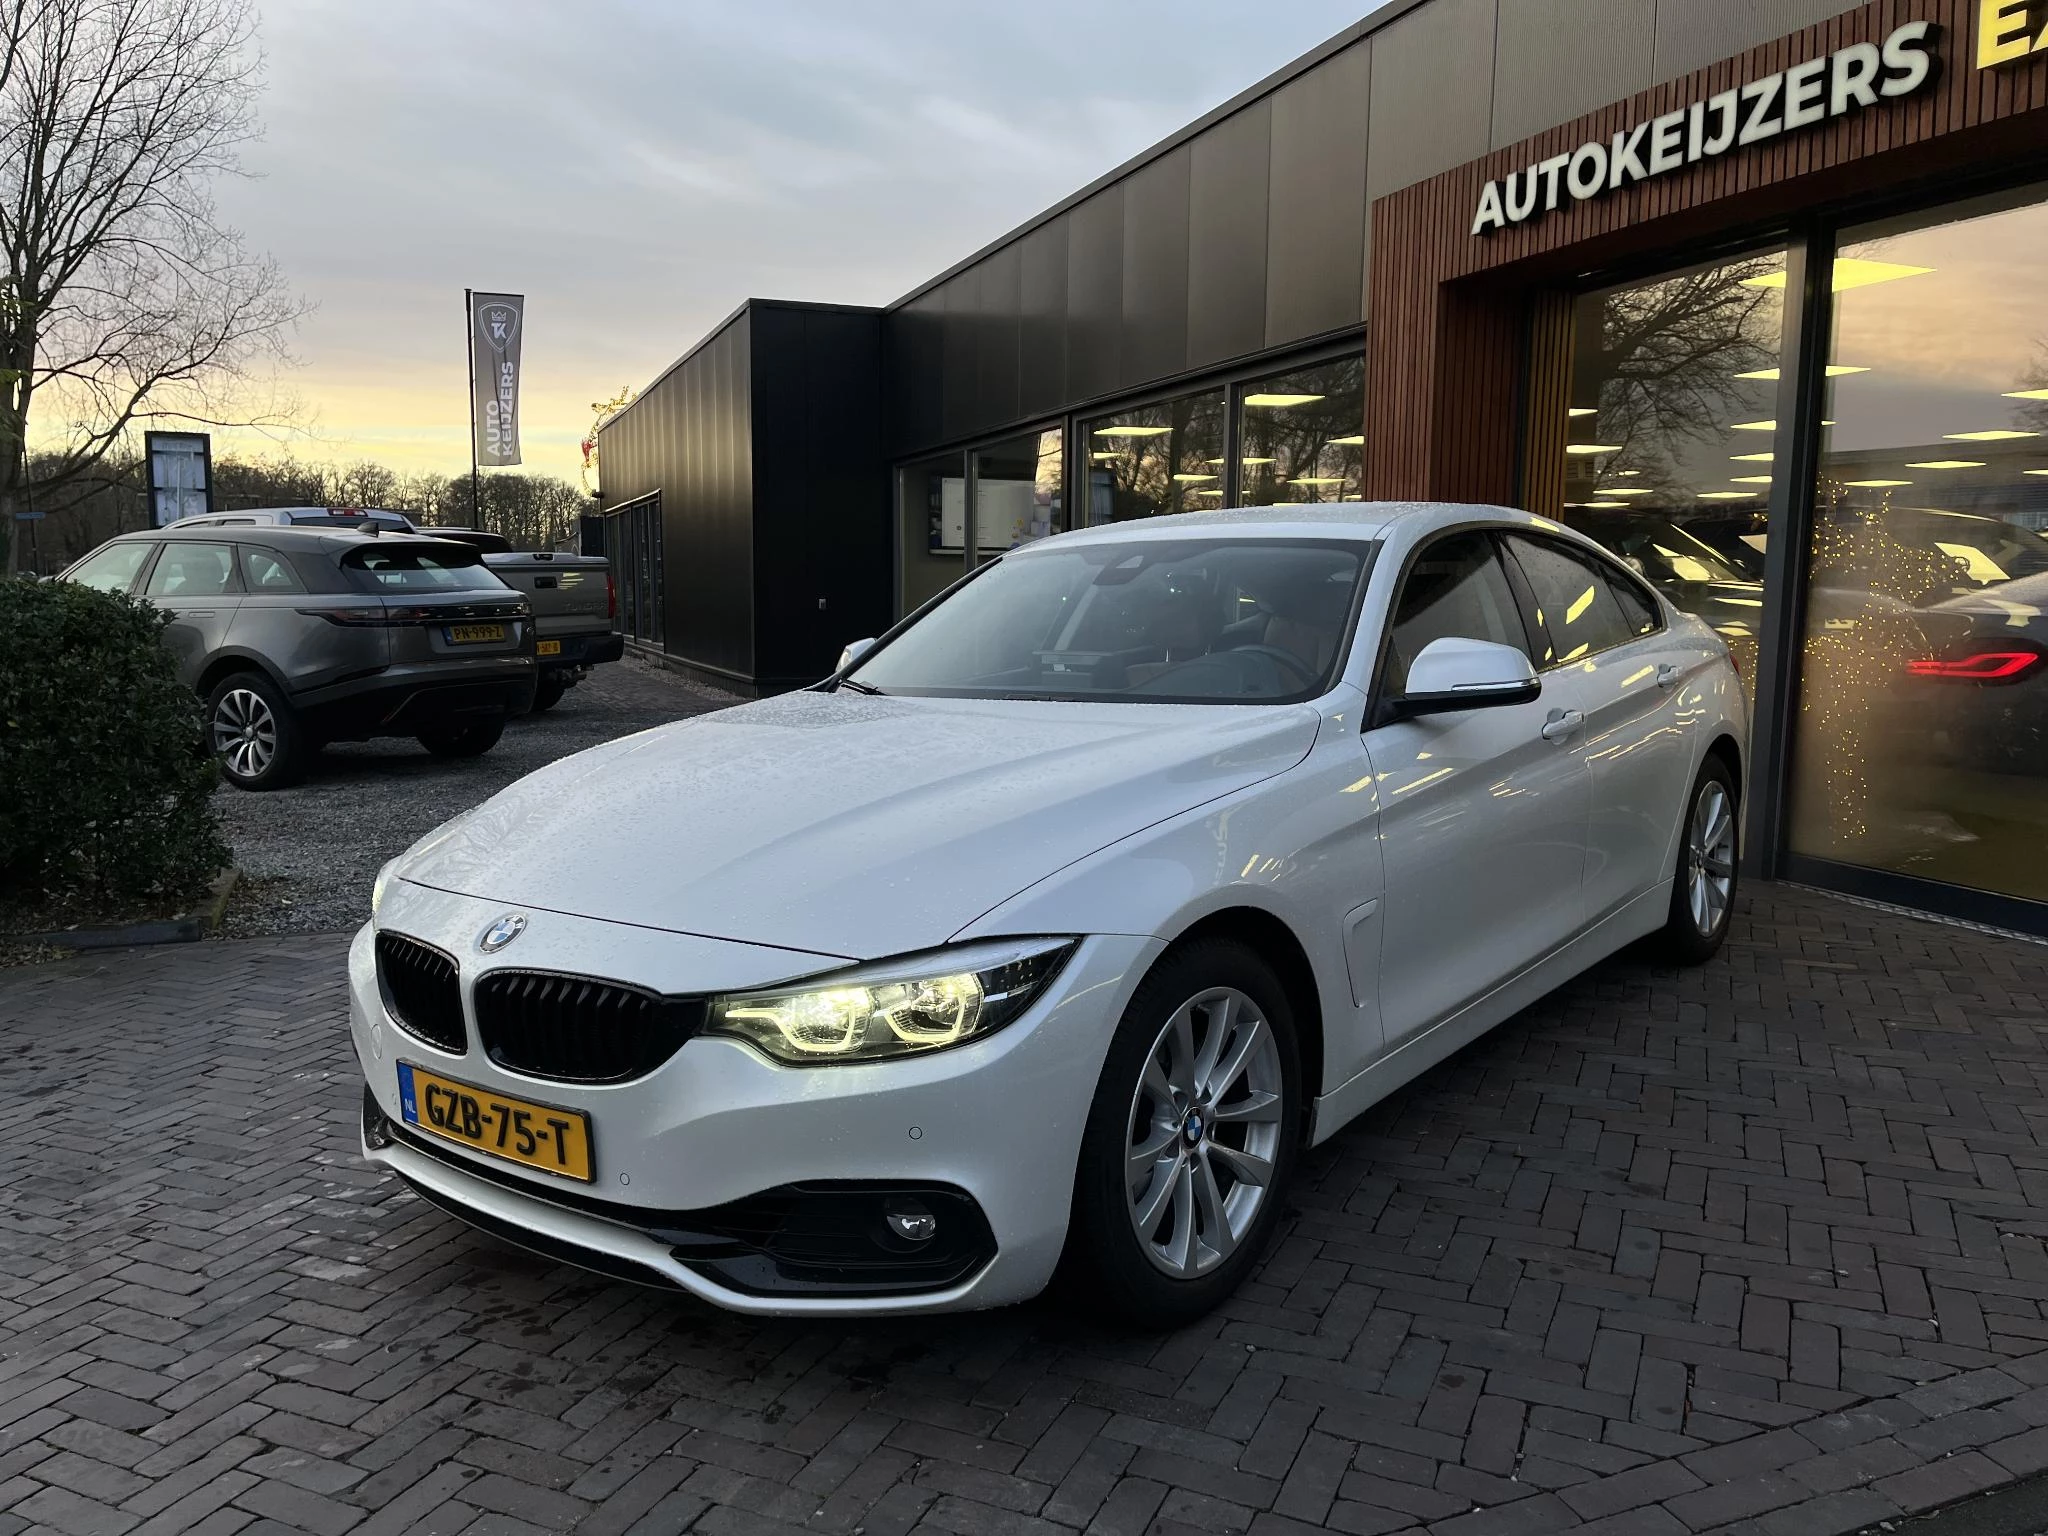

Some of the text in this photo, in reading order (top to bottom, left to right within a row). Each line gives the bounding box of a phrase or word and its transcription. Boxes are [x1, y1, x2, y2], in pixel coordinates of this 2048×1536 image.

[1977, 0, 2048, 70] E
[1472, 20, 1931, 236] AUTOKEIJZERS
[486, 400, 500, 457] AUTO
[501, 361, 514, 456] KEIJZERS
[404, 1098, 417, 1114] NL
[425, 1082, 570, 1165] GZB-75-T
